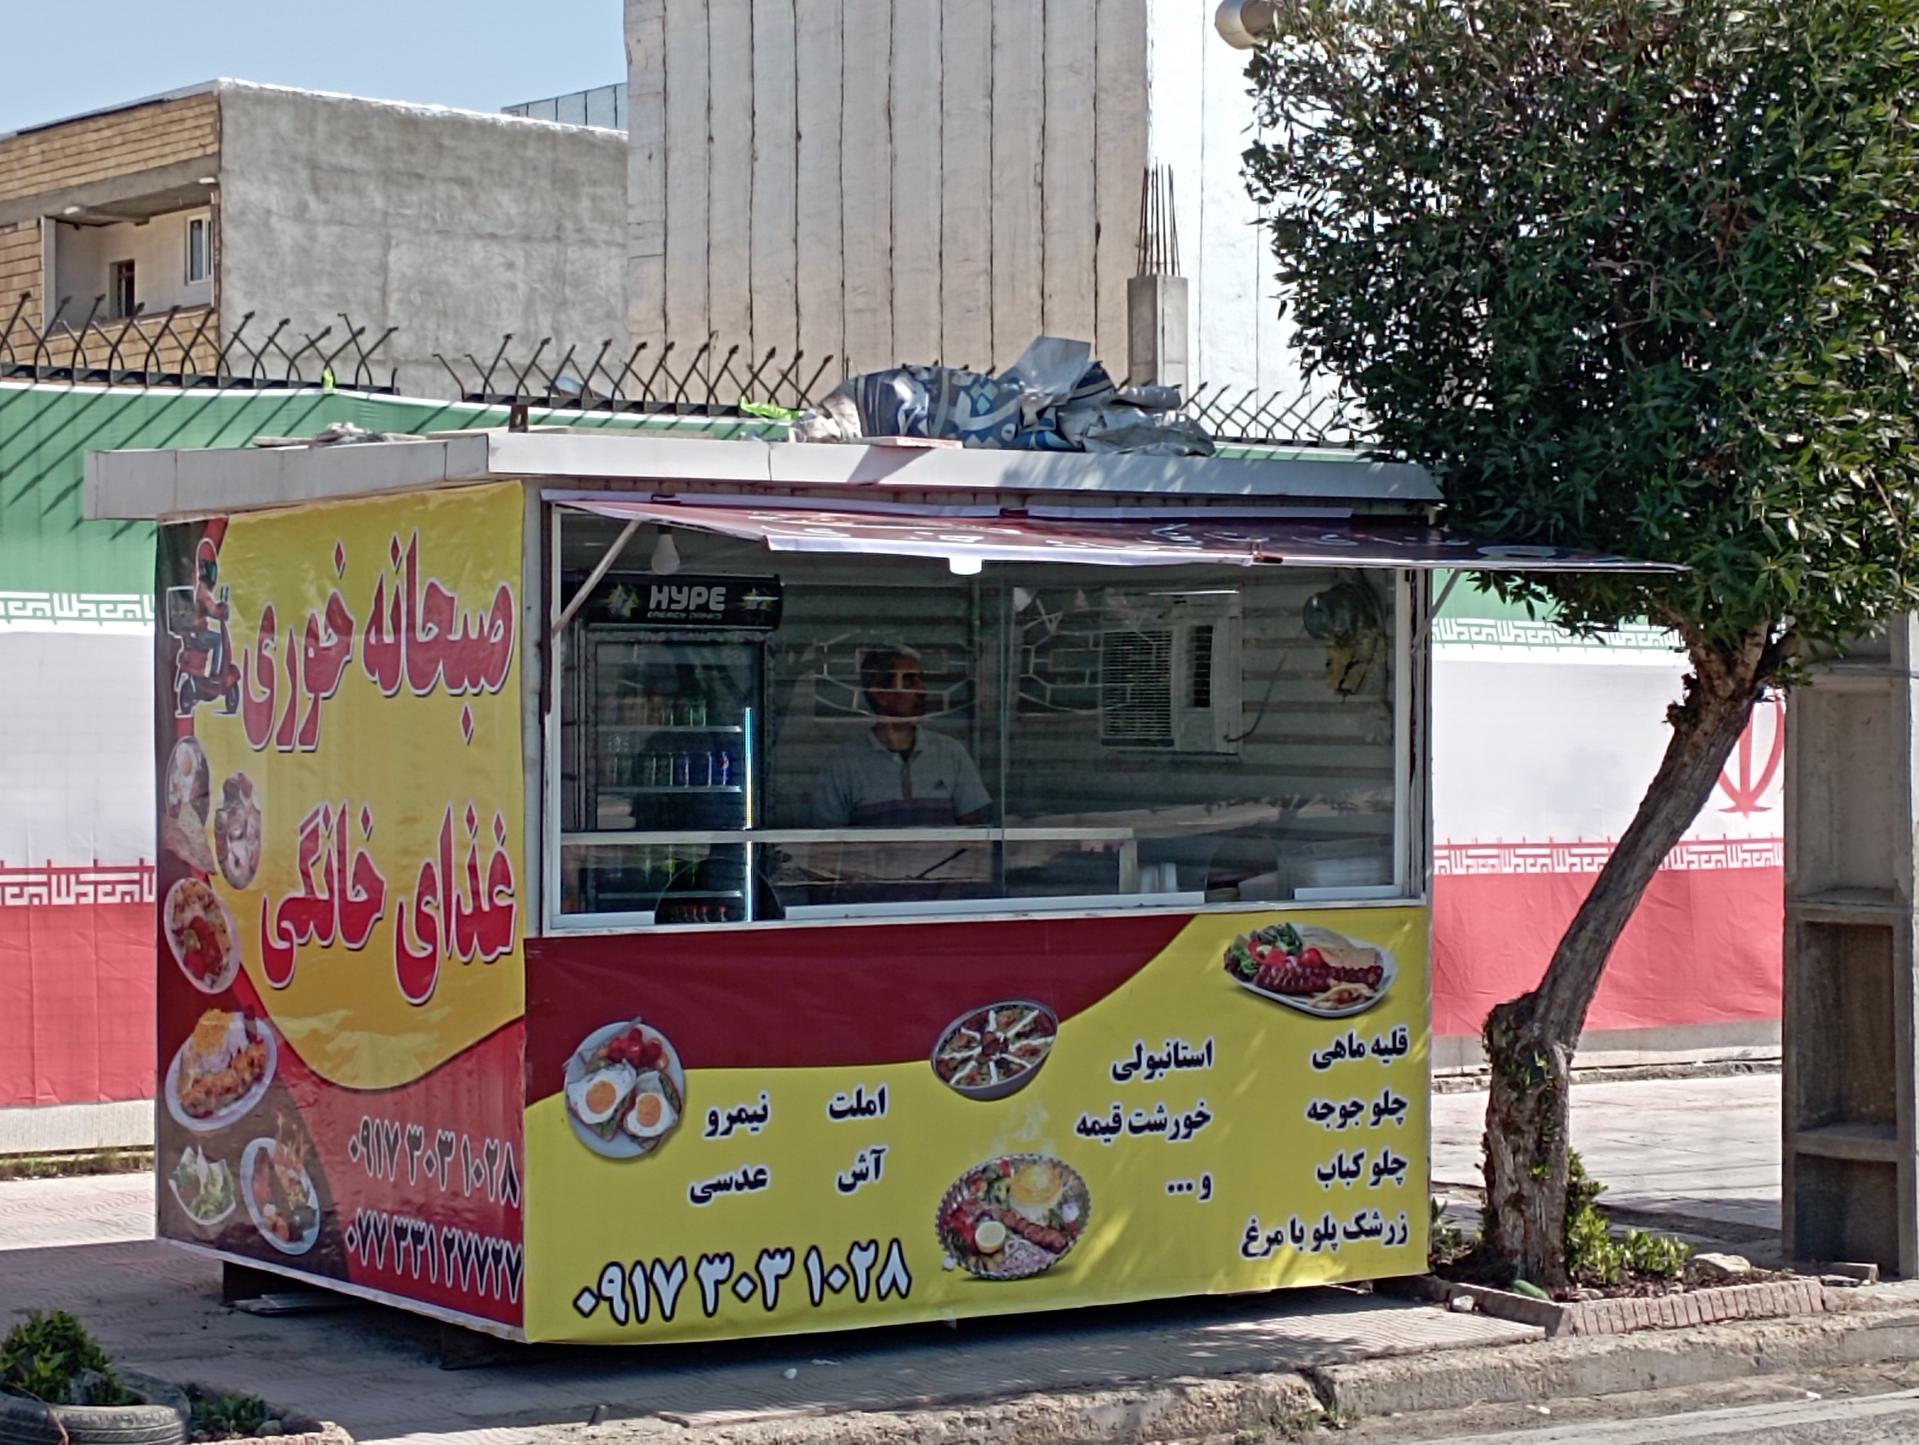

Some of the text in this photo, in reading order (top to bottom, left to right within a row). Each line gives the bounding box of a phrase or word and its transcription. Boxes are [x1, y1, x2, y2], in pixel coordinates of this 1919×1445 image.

[648, 584, 727, 611] HYPE
[242, 526, 516, 753] صبحانه خوری
[259, 798, 518, 1002] غذای خانگی
[1111, 1038, 1214, 1081] استانبولی
[1311, 1026, 1409, 1070] قلیه ماهی
[703, 1093, 769, 1138] نیمرو
[827, 1085, 887, 1121] املت
[1075, 1100, 1212, 1144] خورشت قیمه
[1306, 1088, 1409, 1129] چلو جوجه
[348, 1114, 402, 1183] ۰۹۱۷
[460, 1133, 521, 1209] ۱۰۲۸
[836, 1147, 886, 1192] آش
[1316, 1148, 1408, 1189] چلو کباب
[688, 1165, 769, 1205] عدسی
[1240, 1210, 1409, 1259] زرشک پلو با مرغ
[573, 1236, 913, 1327] ۰۹۱۷ ۳۰۳ ۱۰۲۸
